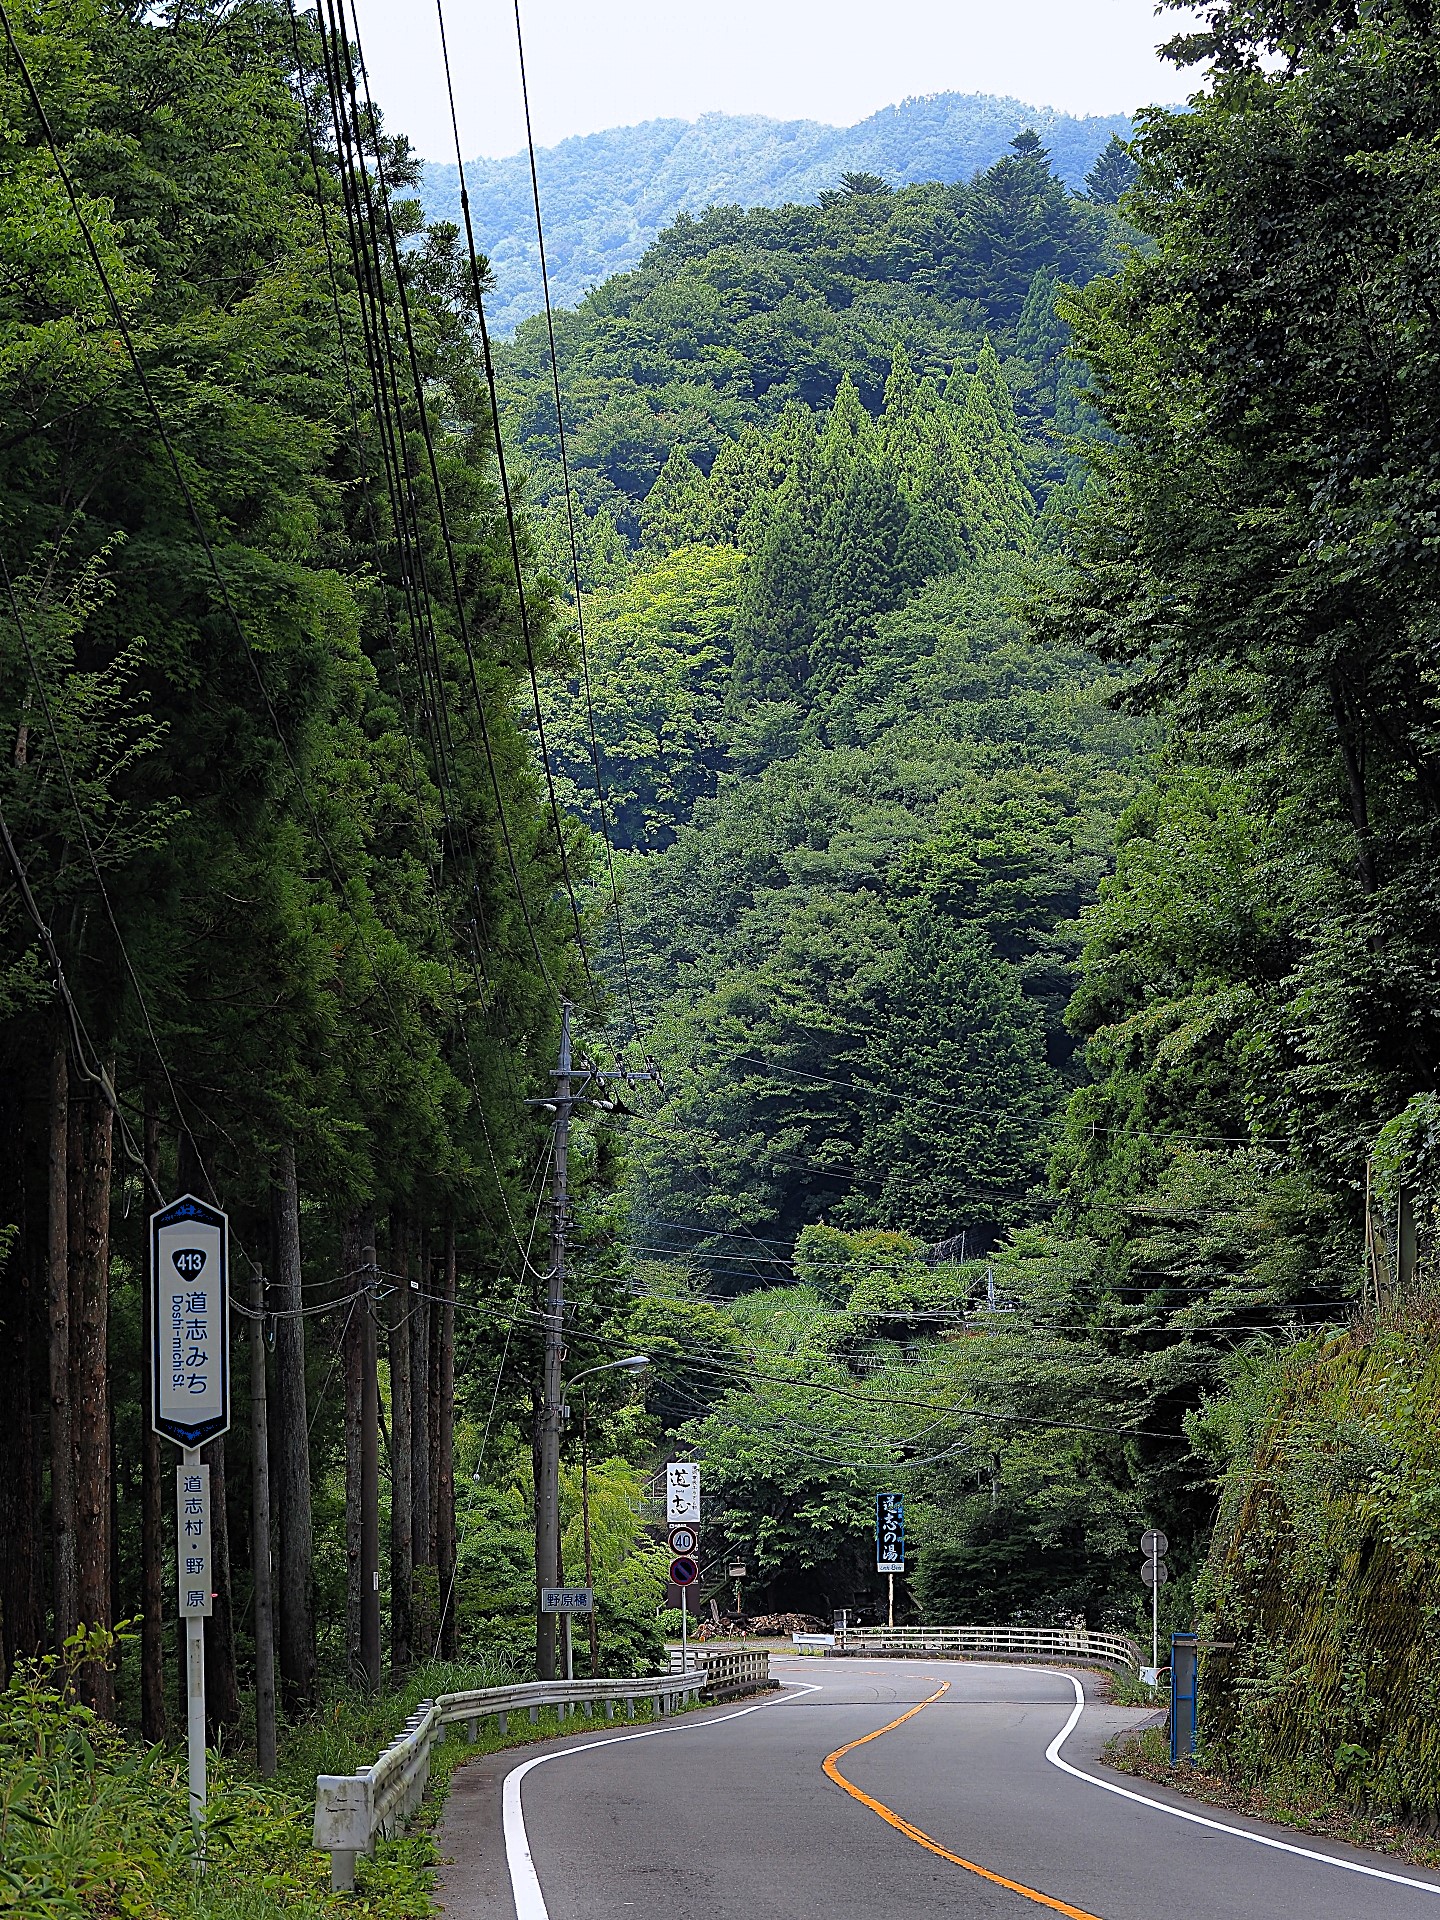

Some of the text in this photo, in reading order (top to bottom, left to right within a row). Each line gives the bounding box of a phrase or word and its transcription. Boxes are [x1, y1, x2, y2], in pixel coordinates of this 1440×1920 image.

[177, 1253, 202, 1271] 413
[171, 1295, 185, 1391] Doshi-michi St.
[185, 1291, 209, 1394] 道志みち
[675, 1534, 691, 1548] 40
[882, 1495, 899, 1562] 道志の湯
[547, 1593, 588, 1607] 野原橋
